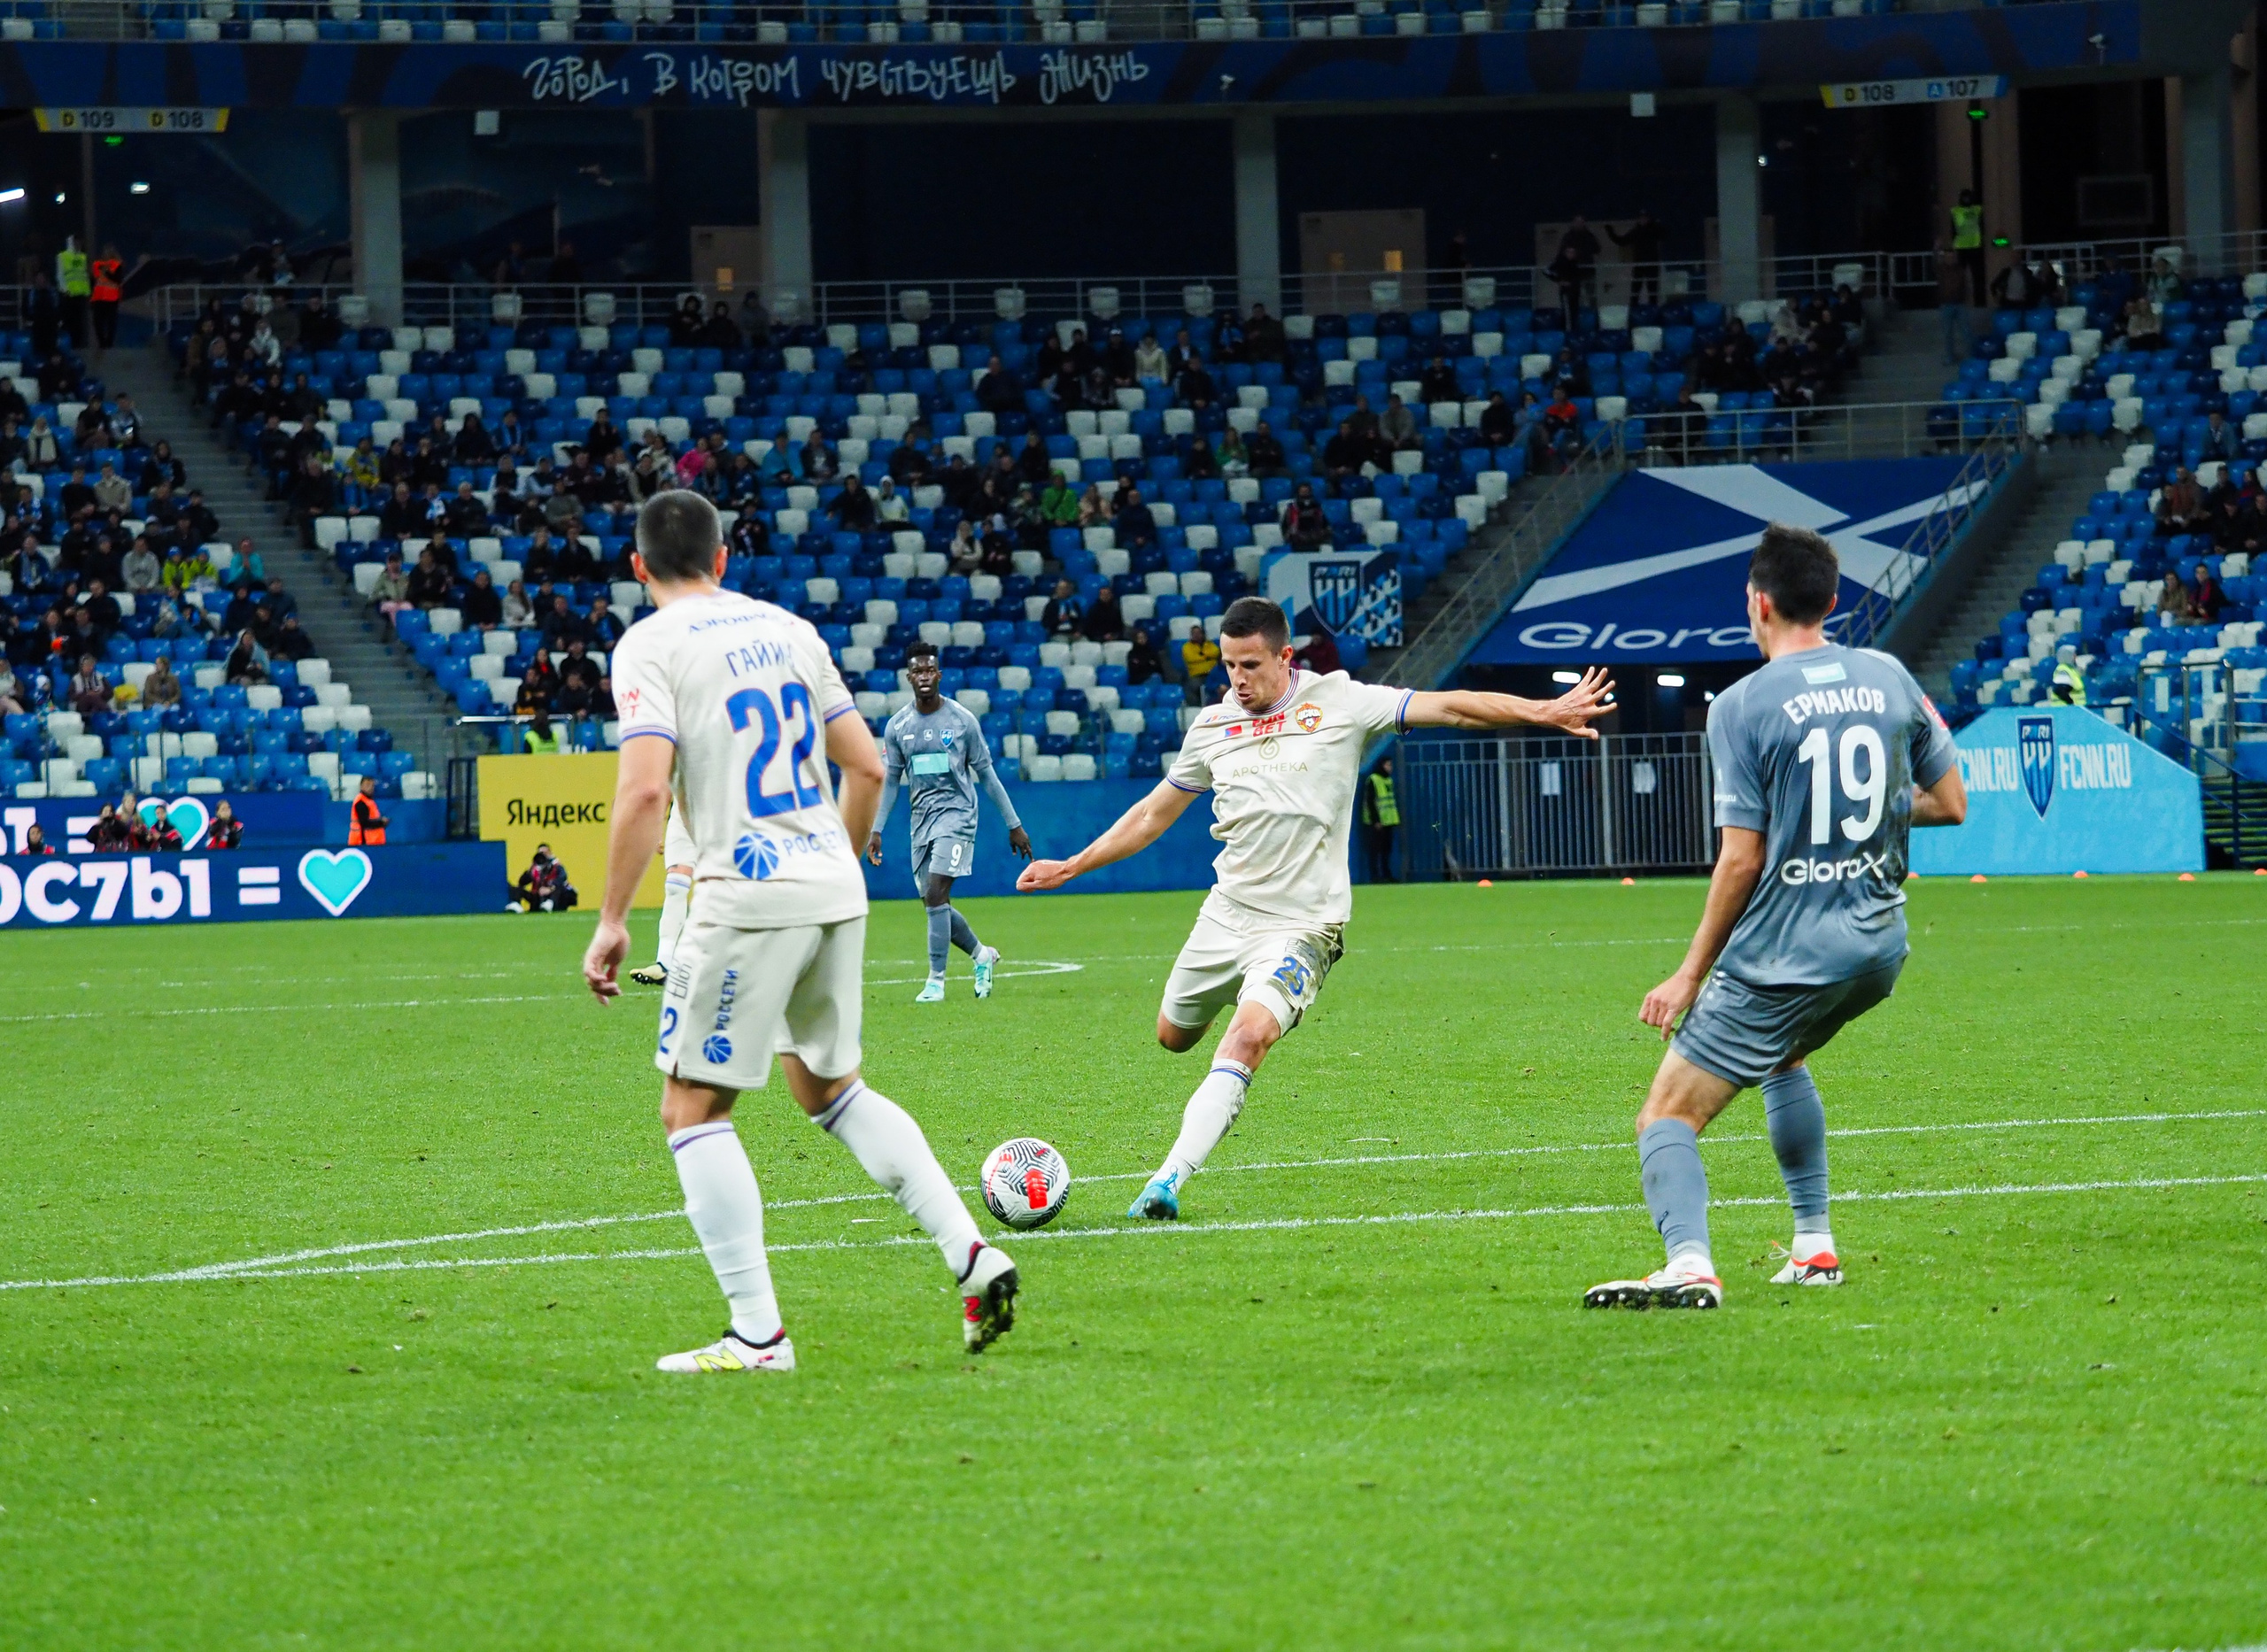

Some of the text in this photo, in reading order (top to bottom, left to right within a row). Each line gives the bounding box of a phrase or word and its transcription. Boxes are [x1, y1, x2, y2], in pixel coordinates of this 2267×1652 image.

[1845, 84, 1895, 102] D 108
[1946, 80, 1978, 97] 107
[63, 111, 115, 128] D 109
[151, 111, 204, 128] D 108
[1519, 611, 1861, 650] Glora
[1782, 687, 1884, 725] ЕРМАКОВ
[725, 681, 824, 819] 22
[2059, 743, 2132, 790] FCNN.RU
[1232, 761, 1308, 779] APOTHEKA
[1799, 724, 1886, 845] 19
[1955, 746, 2018, 792] CNN.RU
[507, 799, 606, 829] Яндекс
[950, 844, 963, 867] 9
[1781, 853, 1886, 885] GloraX
[1273, 956, 1311, 996] 25
[716, 969, 739, 1031] РОССЕТИ
